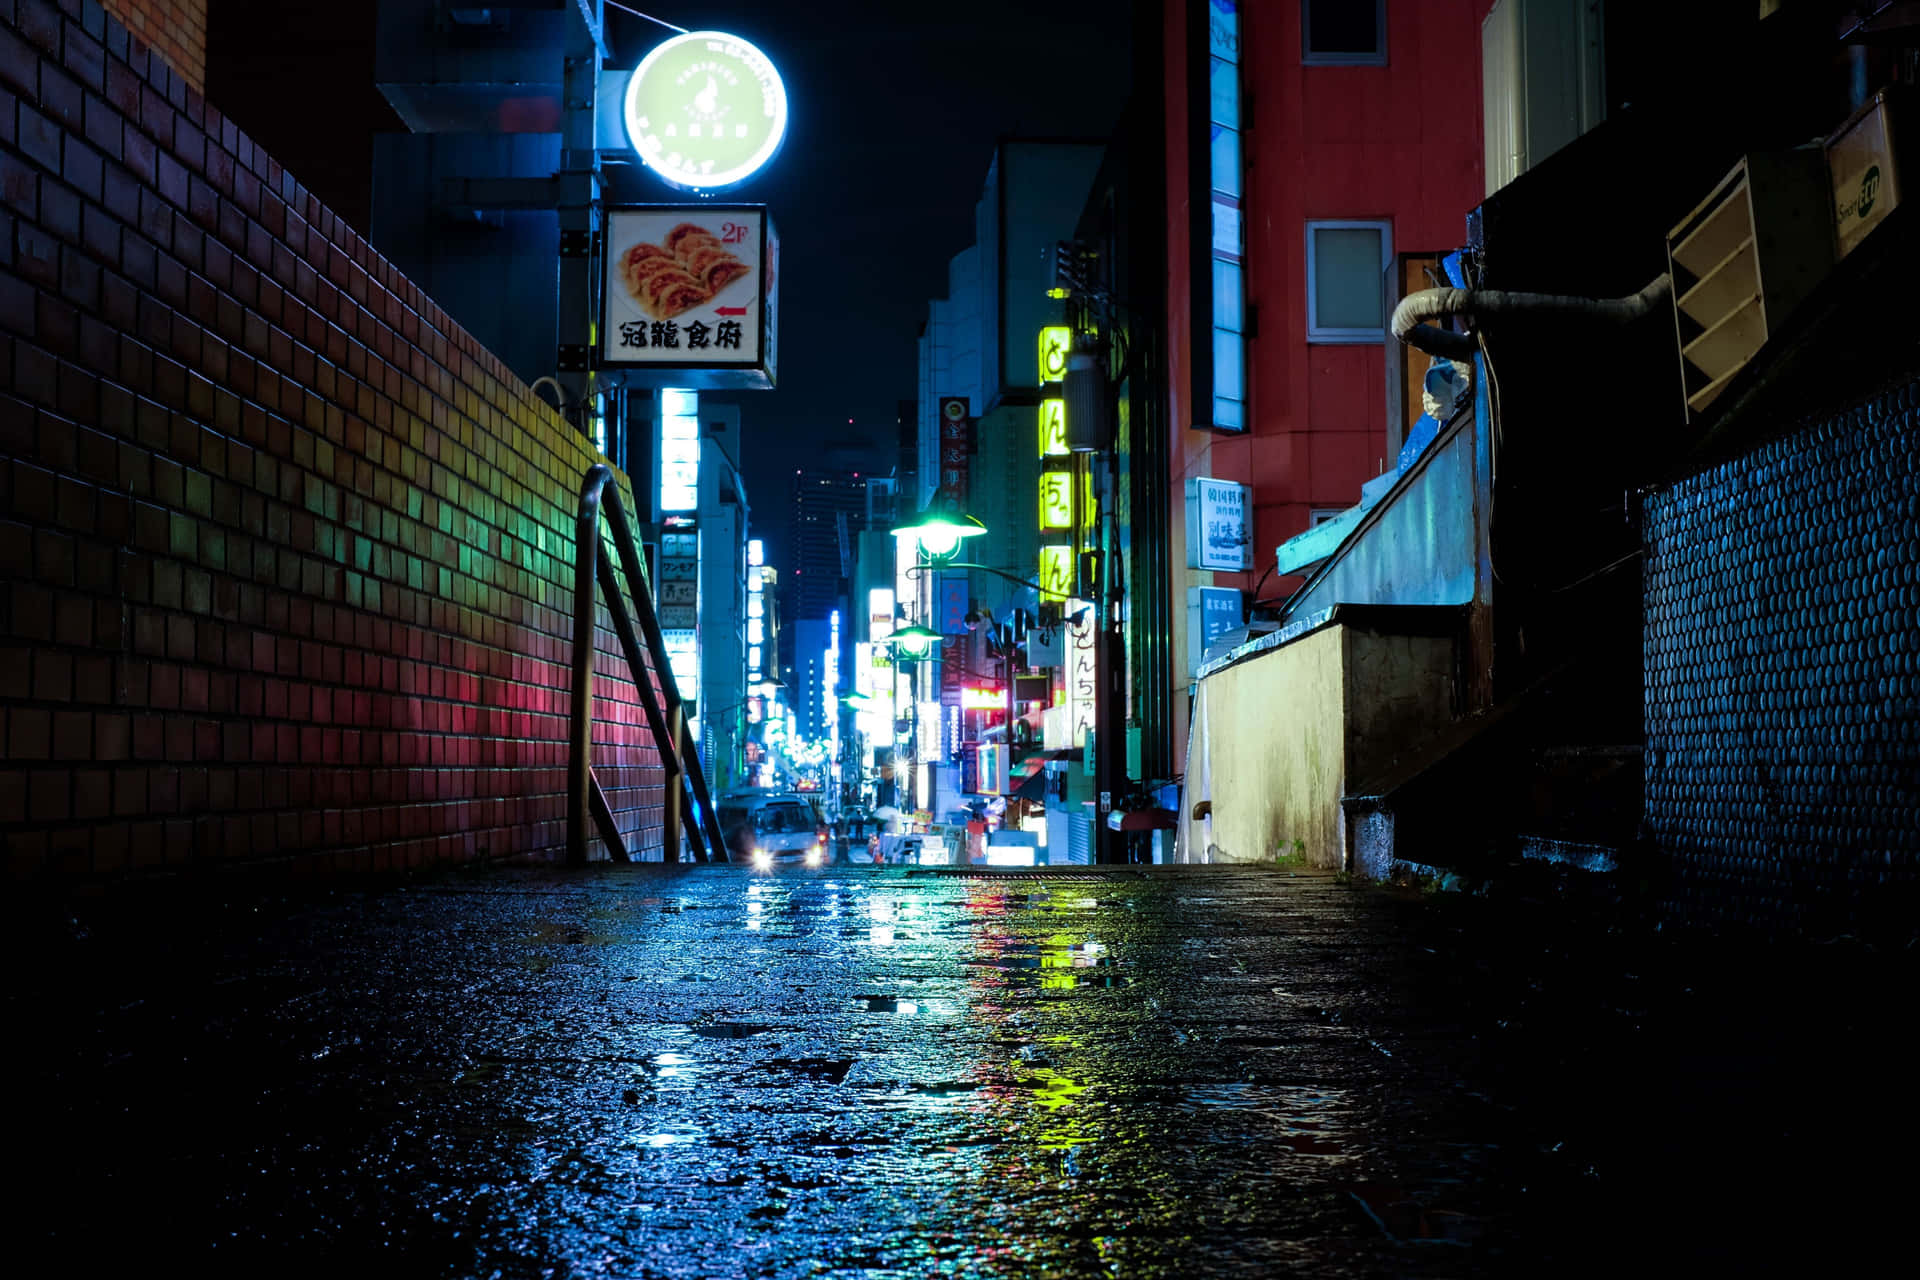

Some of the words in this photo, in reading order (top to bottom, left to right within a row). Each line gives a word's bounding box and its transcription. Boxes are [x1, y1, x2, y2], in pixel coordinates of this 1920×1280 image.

[721, 222, 749, 244] 2F
[1075, 631, 1097, 736] とんちゃん
